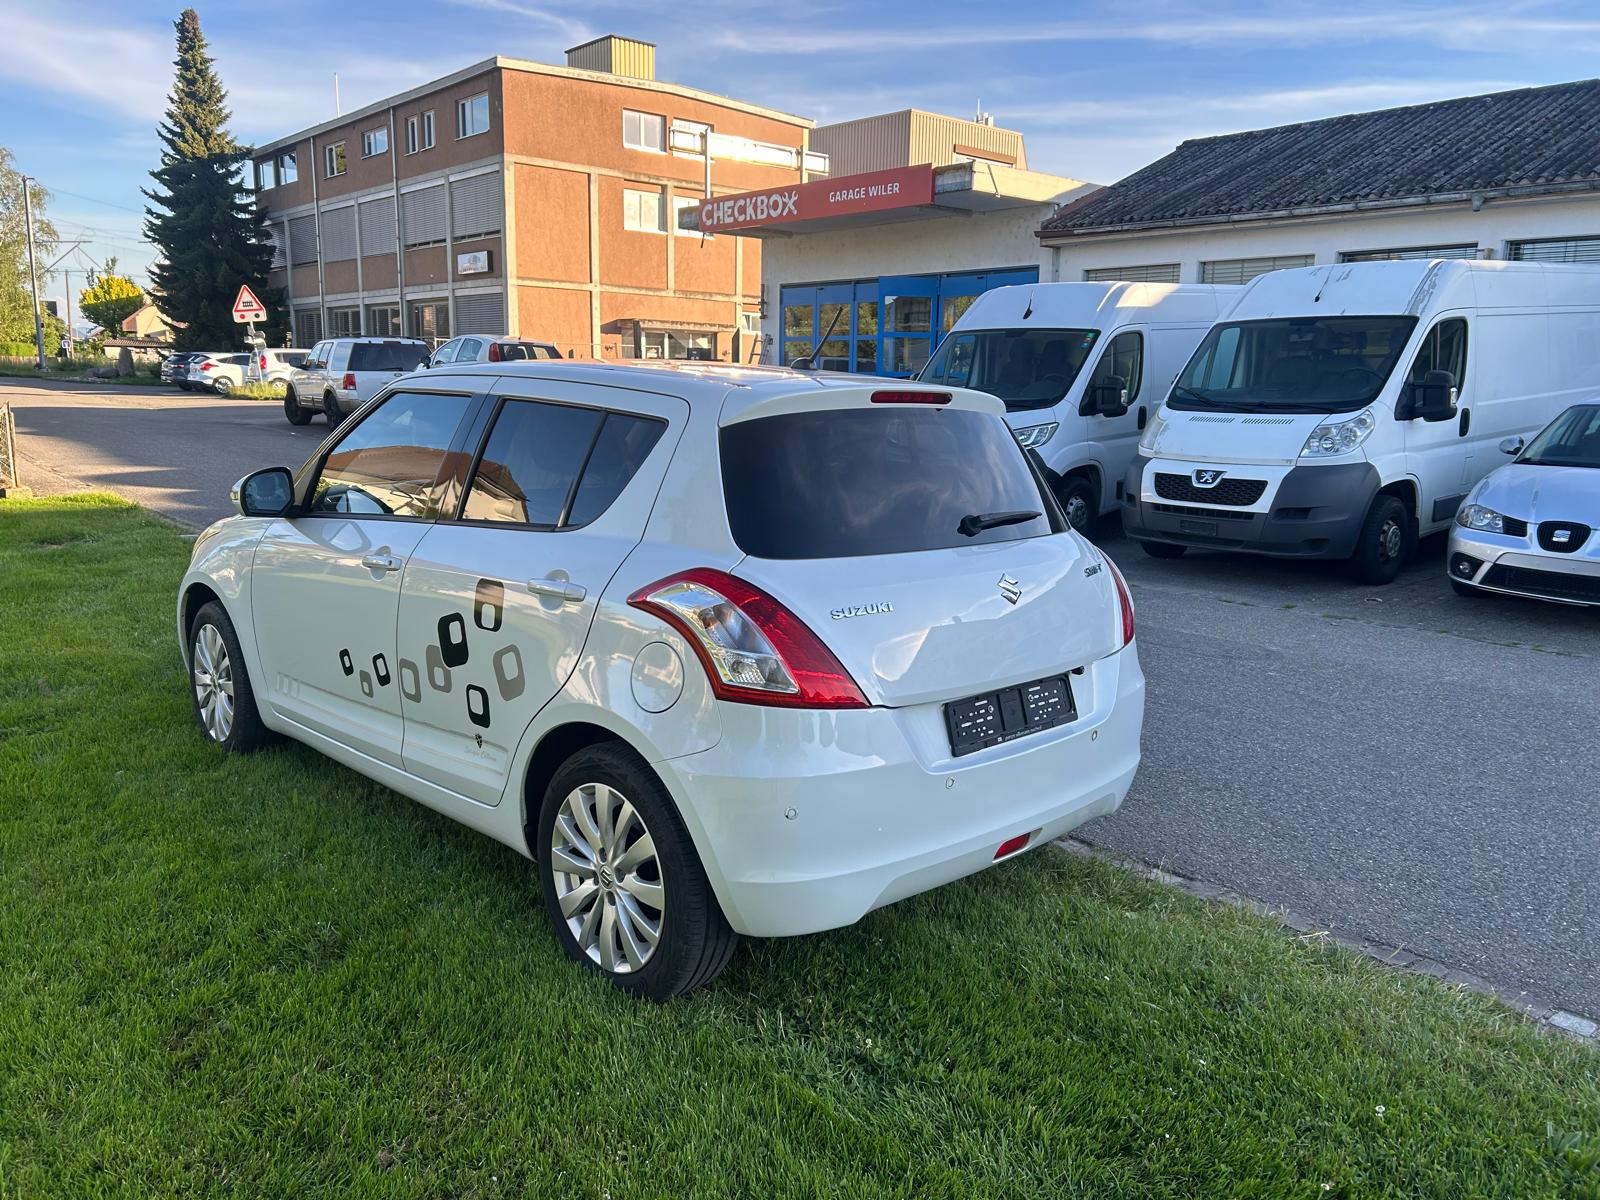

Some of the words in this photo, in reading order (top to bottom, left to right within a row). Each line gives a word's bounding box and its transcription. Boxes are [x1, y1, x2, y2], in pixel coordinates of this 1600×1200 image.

[829, 187, 866, 203] GARAGE
[868, 182, 900, 197] WILER
[701, 190, 799, 226] CHECKBOX
[830, 601, 894, 620] SUZUKI
